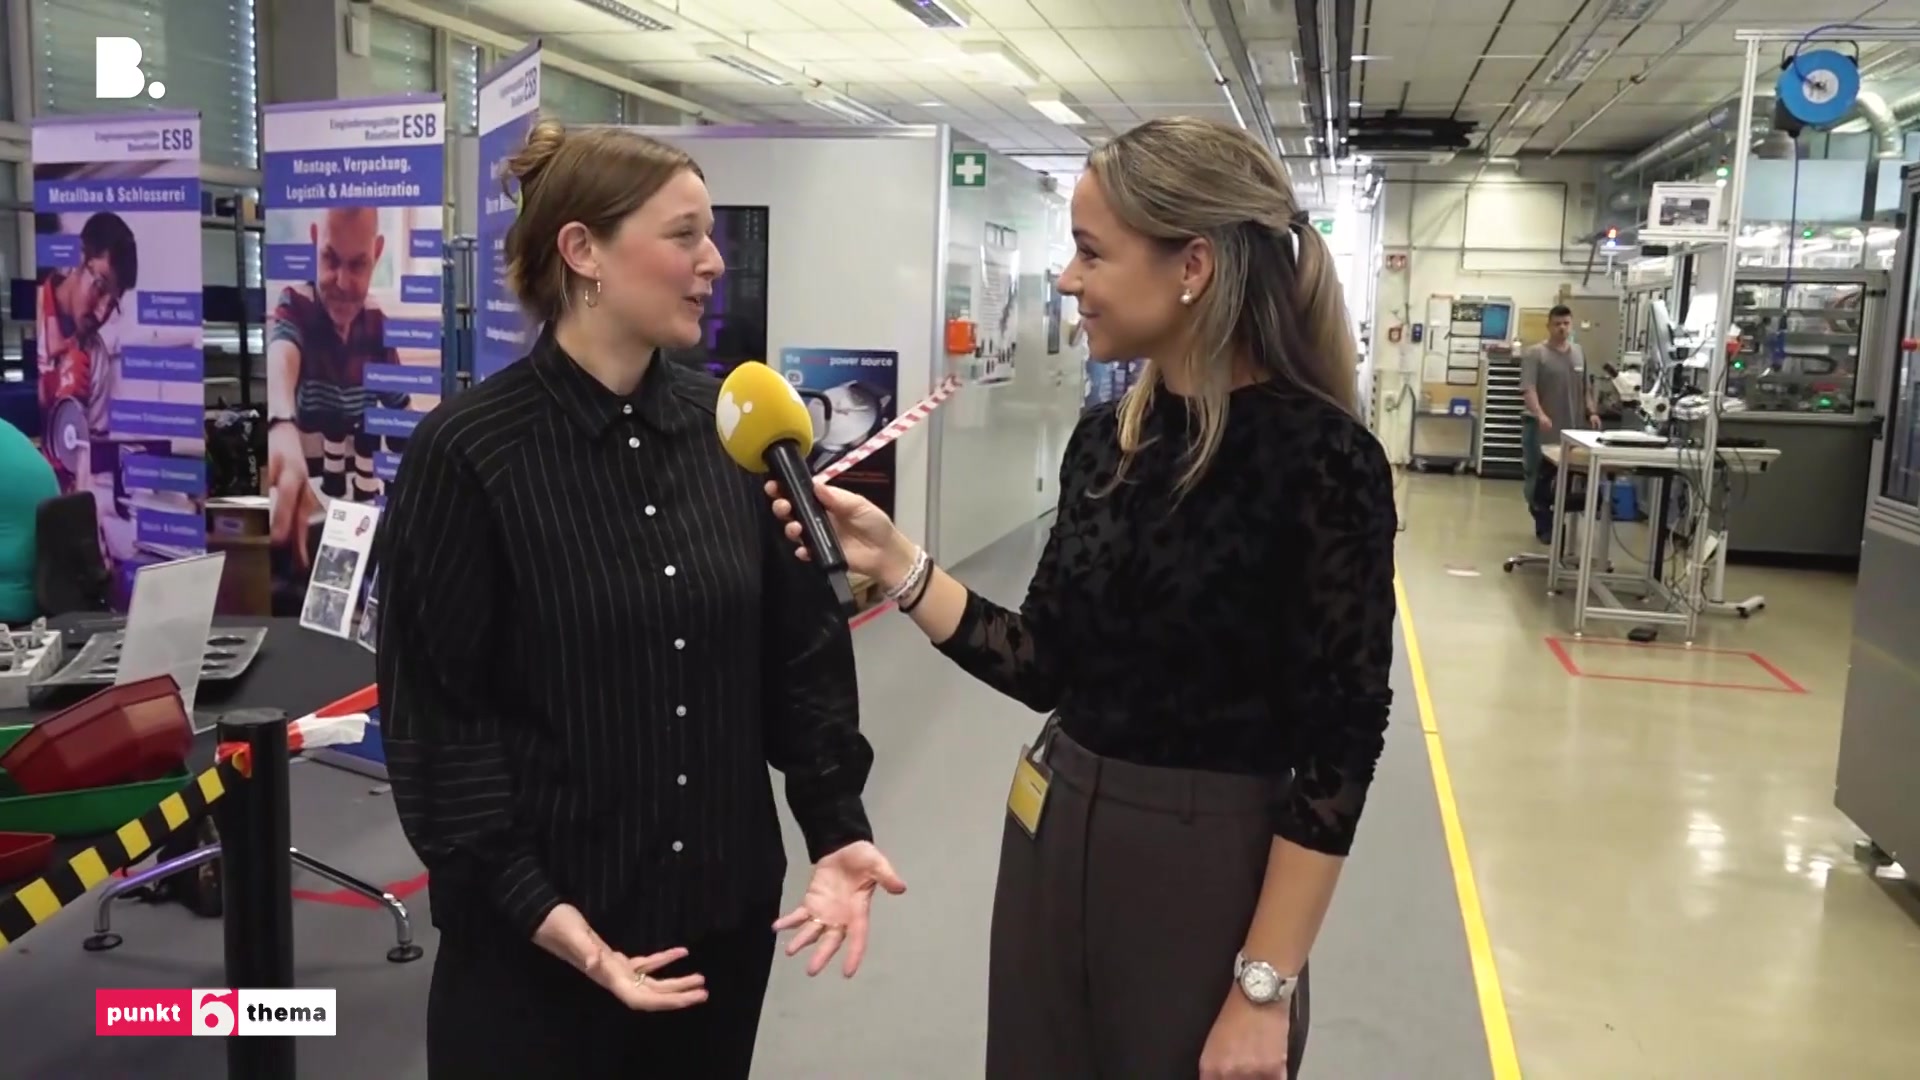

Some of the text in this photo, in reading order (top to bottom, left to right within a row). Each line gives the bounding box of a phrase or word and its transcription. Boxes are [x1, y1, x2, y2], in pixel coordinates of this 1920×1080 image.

[524, 67, 538, 100] ESB
[402, 114, 436, 138] ESB
[162, 129, 193, 151] ESB
[343, 155, 411, 174] Verpackung,
[49, 185, 186, 203] Metallbau & Schlosserei
[286, 181, 420, 202] Logistik & Administration
[785, 354, 801, 364] the
[829, 357, 860, 367] power
[860, 357, 893, 367] source
